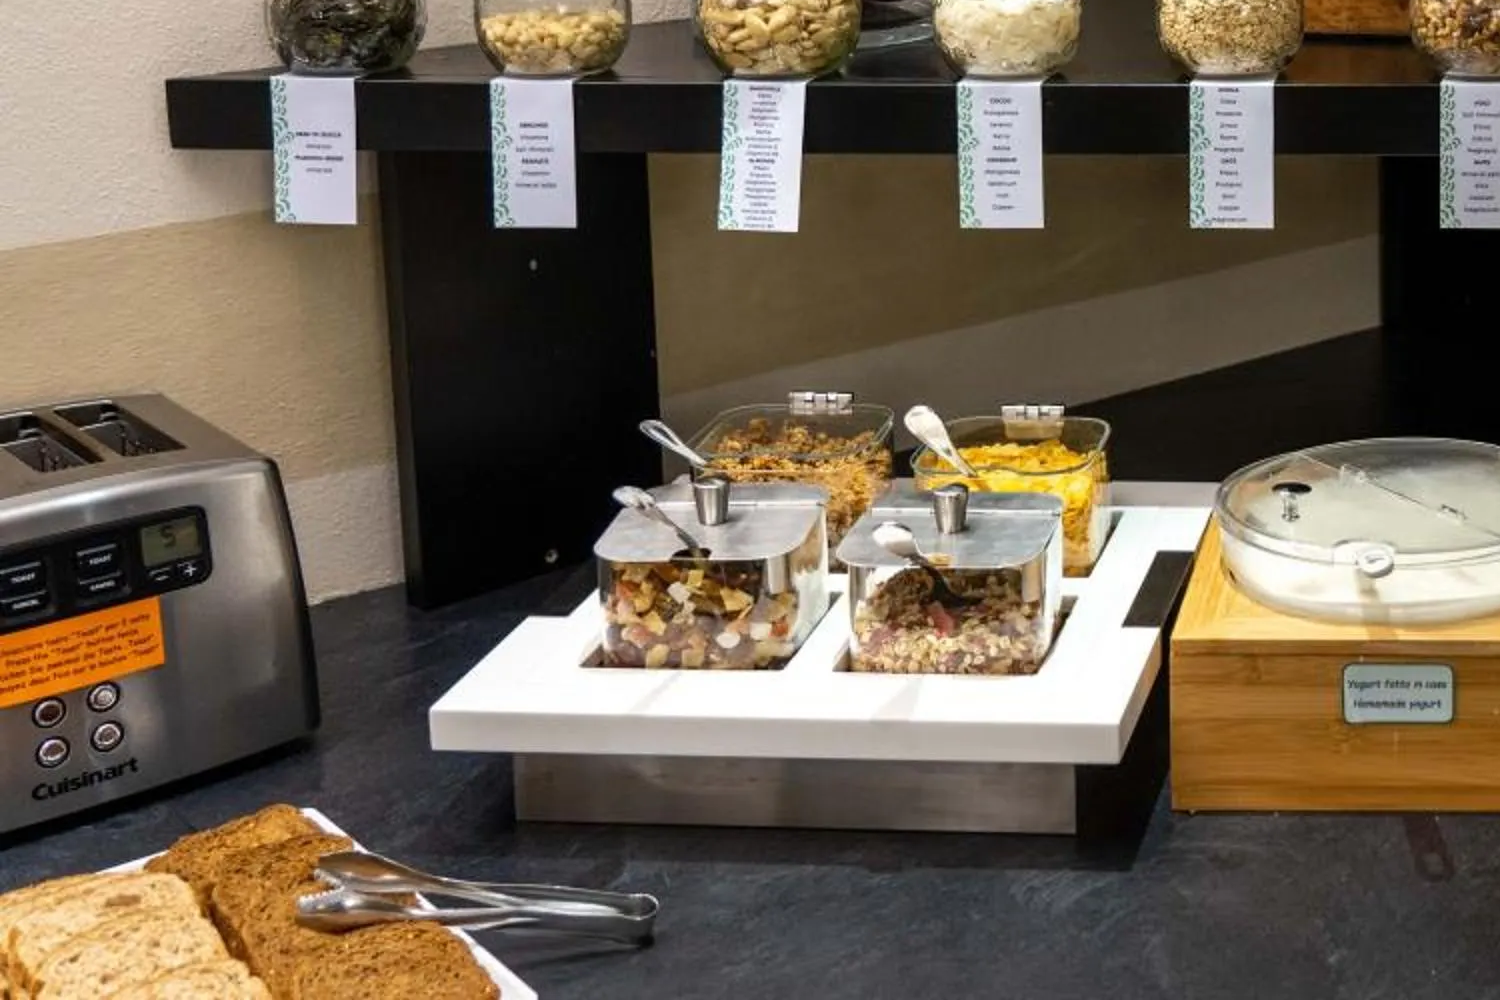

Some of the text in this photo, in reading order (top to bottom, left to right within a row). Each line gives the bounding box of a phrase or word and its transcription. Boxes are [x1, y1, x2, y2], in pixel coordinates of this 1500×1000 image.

[1347, 679, 1382, 692] Yogurt
[1409, 699, 1442, 712] yogurt
[31, 757, 139, 801] Cuisinart
